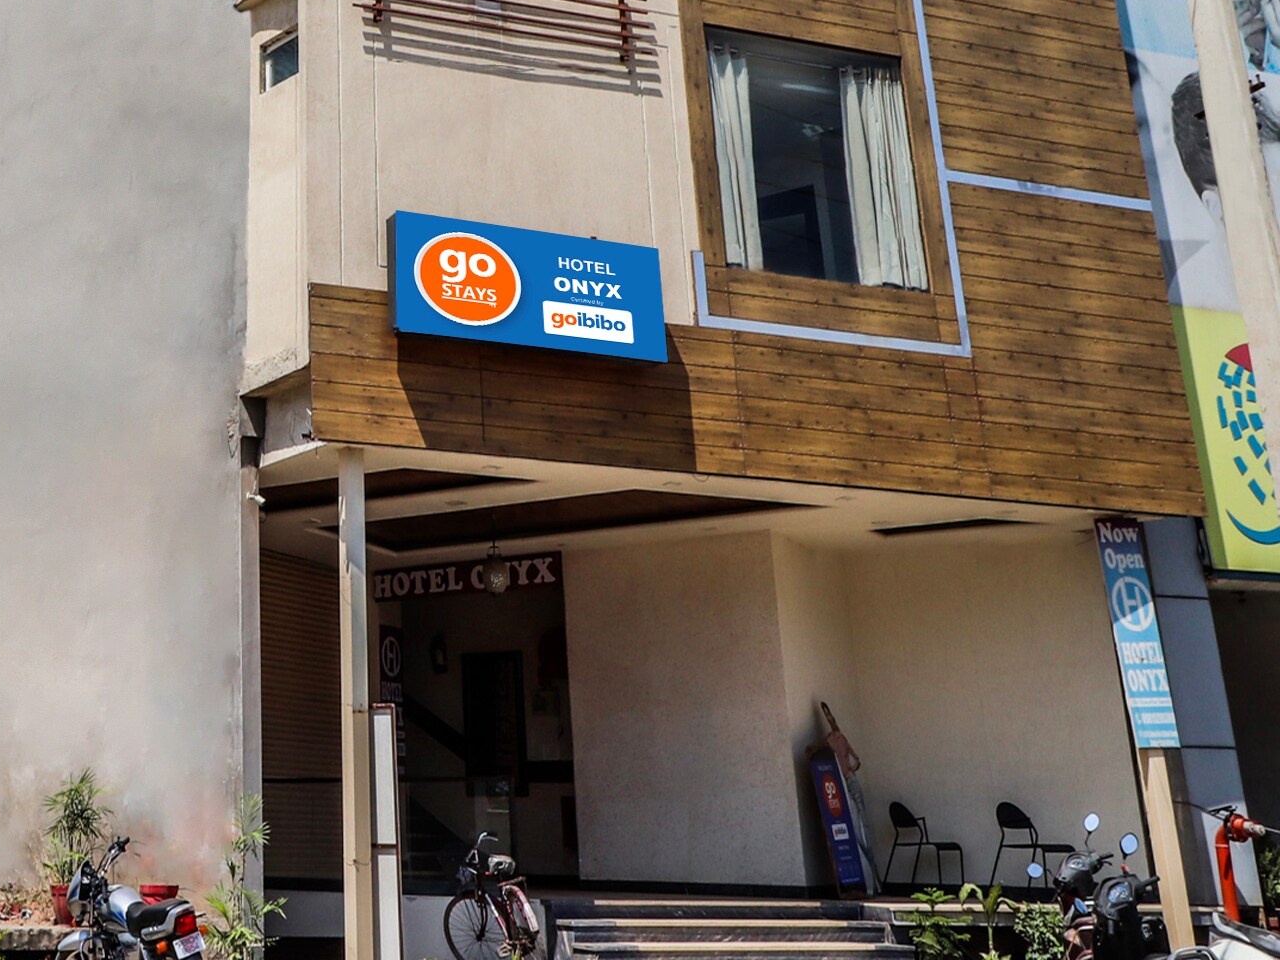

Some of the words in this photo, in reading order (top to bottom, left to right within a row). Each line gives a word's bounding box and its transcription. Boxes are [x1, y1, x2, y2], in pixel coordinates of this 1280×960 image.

[439, 248, 497, 283] go
[558, 256, 616, 276] HOTEL
[441, 283, 497, 302] STAYS
[553, 276, 623, 300] ONYX
[551, 312, 626, 331] goibibo
[1097, 522, 1139, 543] Now
[1104, 548, 1145, 573] Open
[374, 566, 464, 599] HOTEL
[471, 557, 556, 589] OYX
[1121, 642, 1165, 664] HOTEL
[1127, 669, 1169, 692] ONYX
